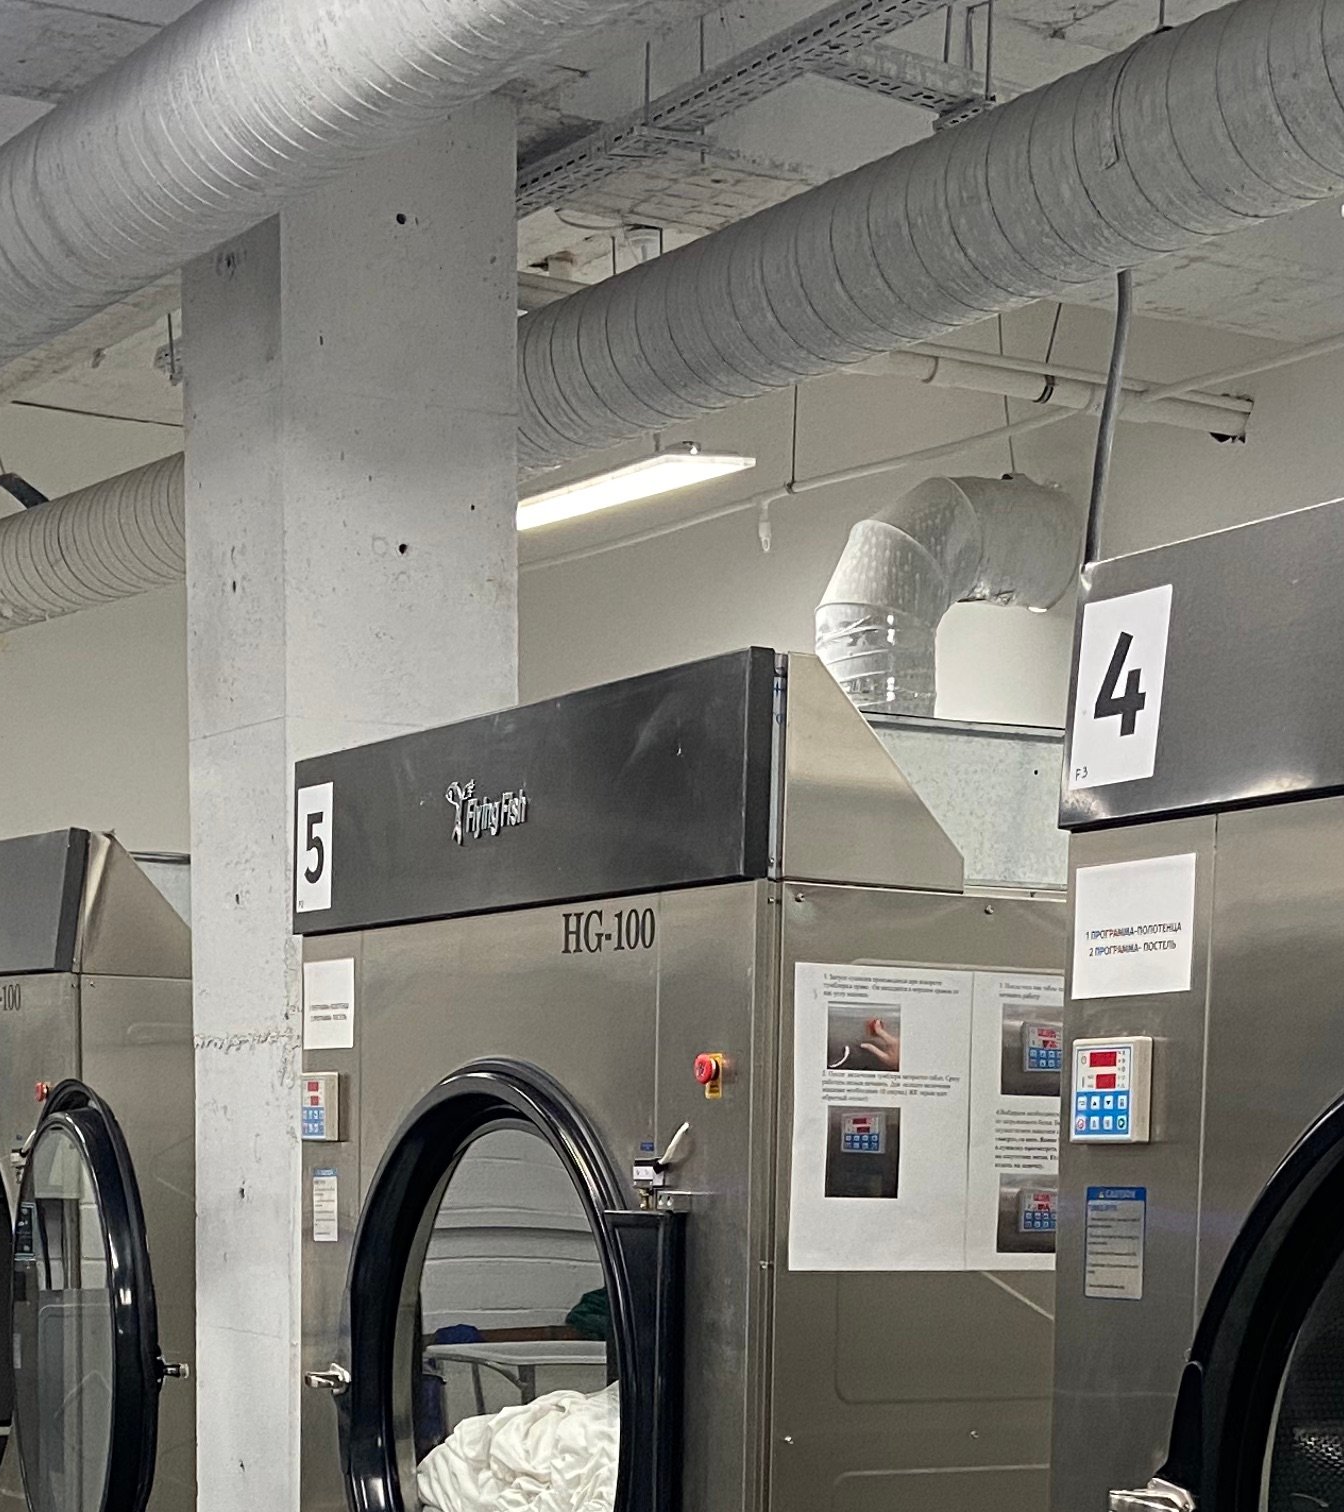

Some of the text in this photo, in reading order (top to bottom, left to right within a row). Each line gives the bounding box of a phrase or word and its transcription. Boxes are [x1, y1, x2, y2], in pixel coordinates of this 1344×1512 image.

[1093, 631, 1146, 737] 4
[303, 811, 325, 885] 5
[561, 907, 656, 954] HG-100
